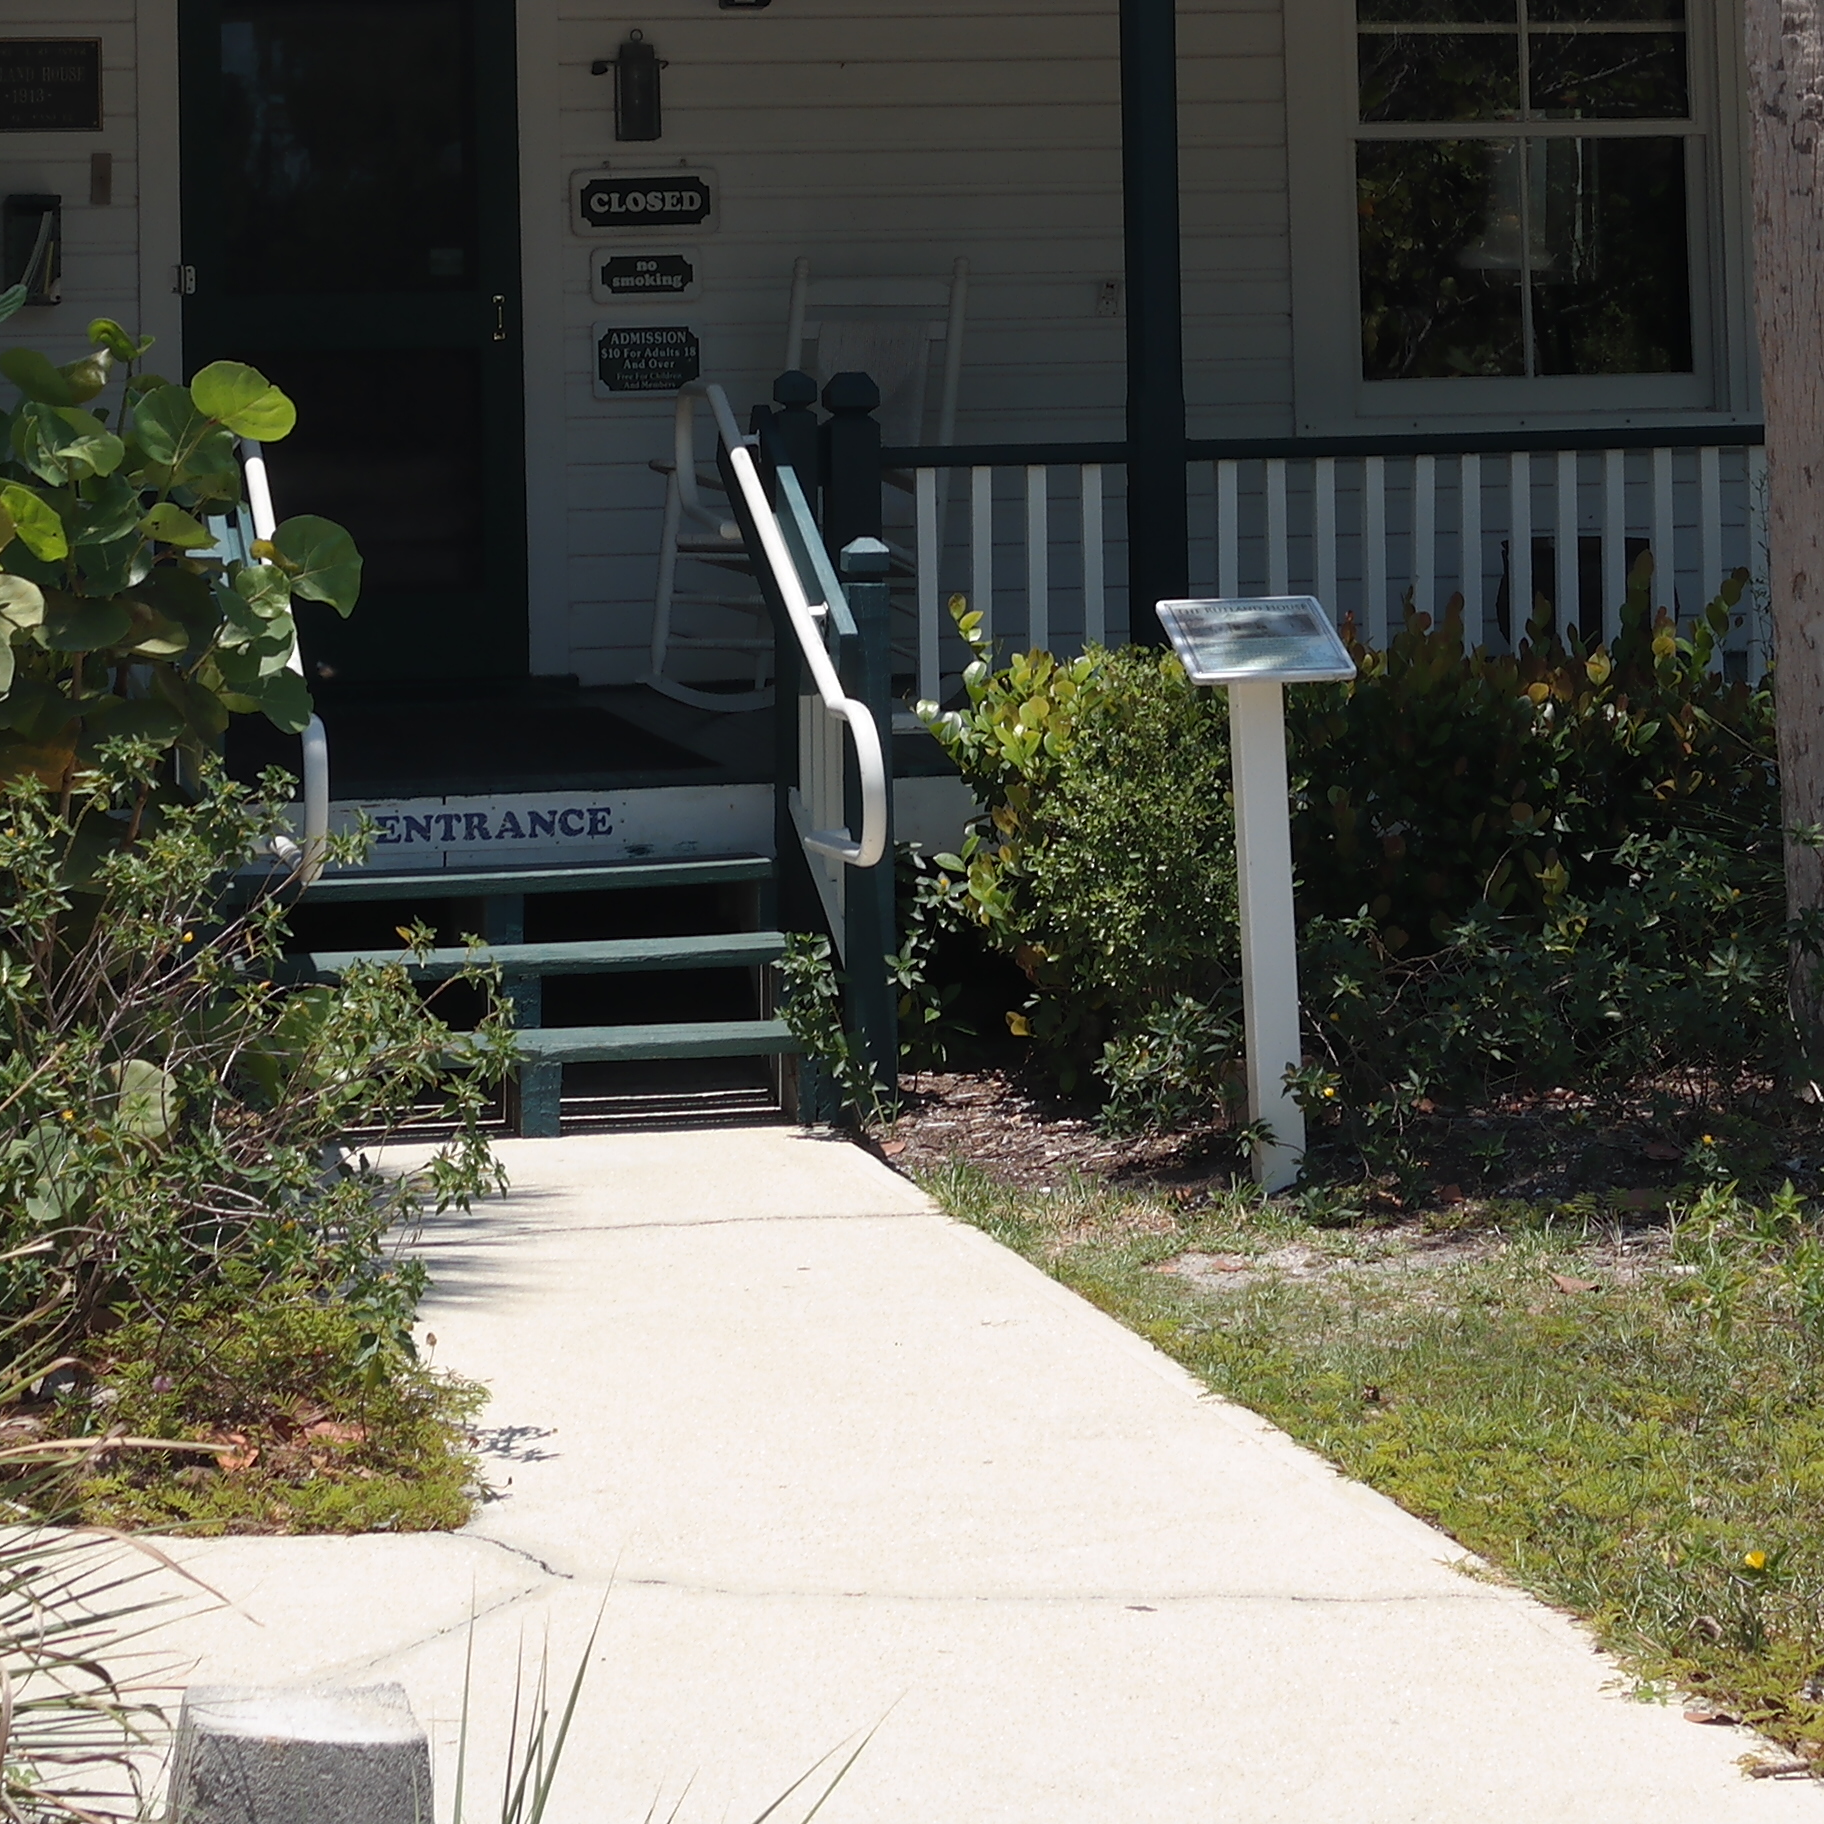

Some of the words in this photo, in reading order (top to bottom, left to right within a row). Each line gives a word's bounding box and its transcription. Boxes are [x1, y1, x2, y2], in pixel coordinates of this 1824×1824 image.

[42, 66, 86, 82] HOUSE
[589, 190, 702, 214] CLOSED
[636, 259, 658, 272] no
[612, 273, 684, 288] smoking
[610, 331, 687, 345] ADMISSION
[601, 347, 621, 359] $10
[623, 347, 641, 358] For
[644, 346, 680, 358] Adults
[684, 346, 696, 357] 18
[623, 359, 645, 369] And
[648, 358, 675, 369] Over
[1265, 603, 1308, 612] HOUSE
[374, 806, 614, 845] ENTRANCE
